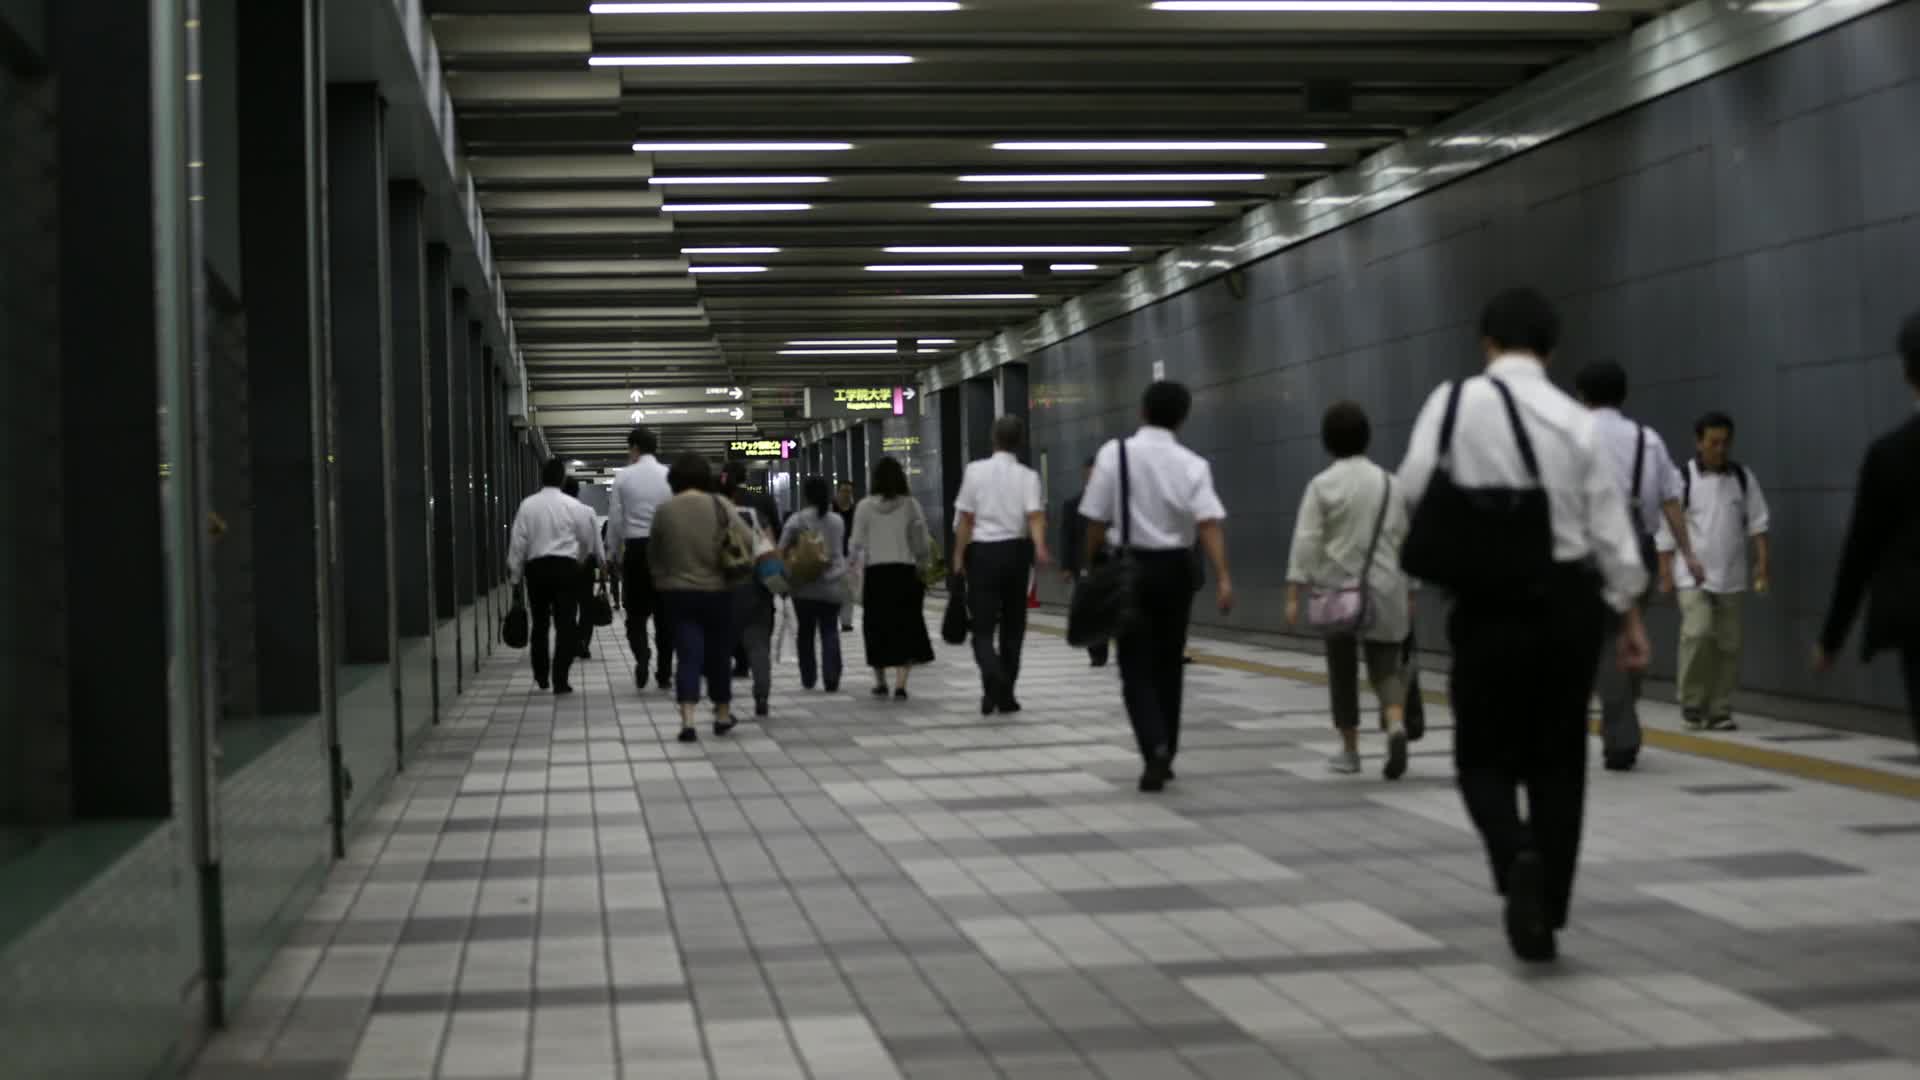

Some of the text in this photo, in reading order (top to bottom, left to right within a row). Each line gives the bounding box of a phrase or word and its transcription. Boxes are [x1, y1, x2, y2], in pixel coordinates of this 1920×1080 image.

[833, 388, 892, 401] 工学院大学
